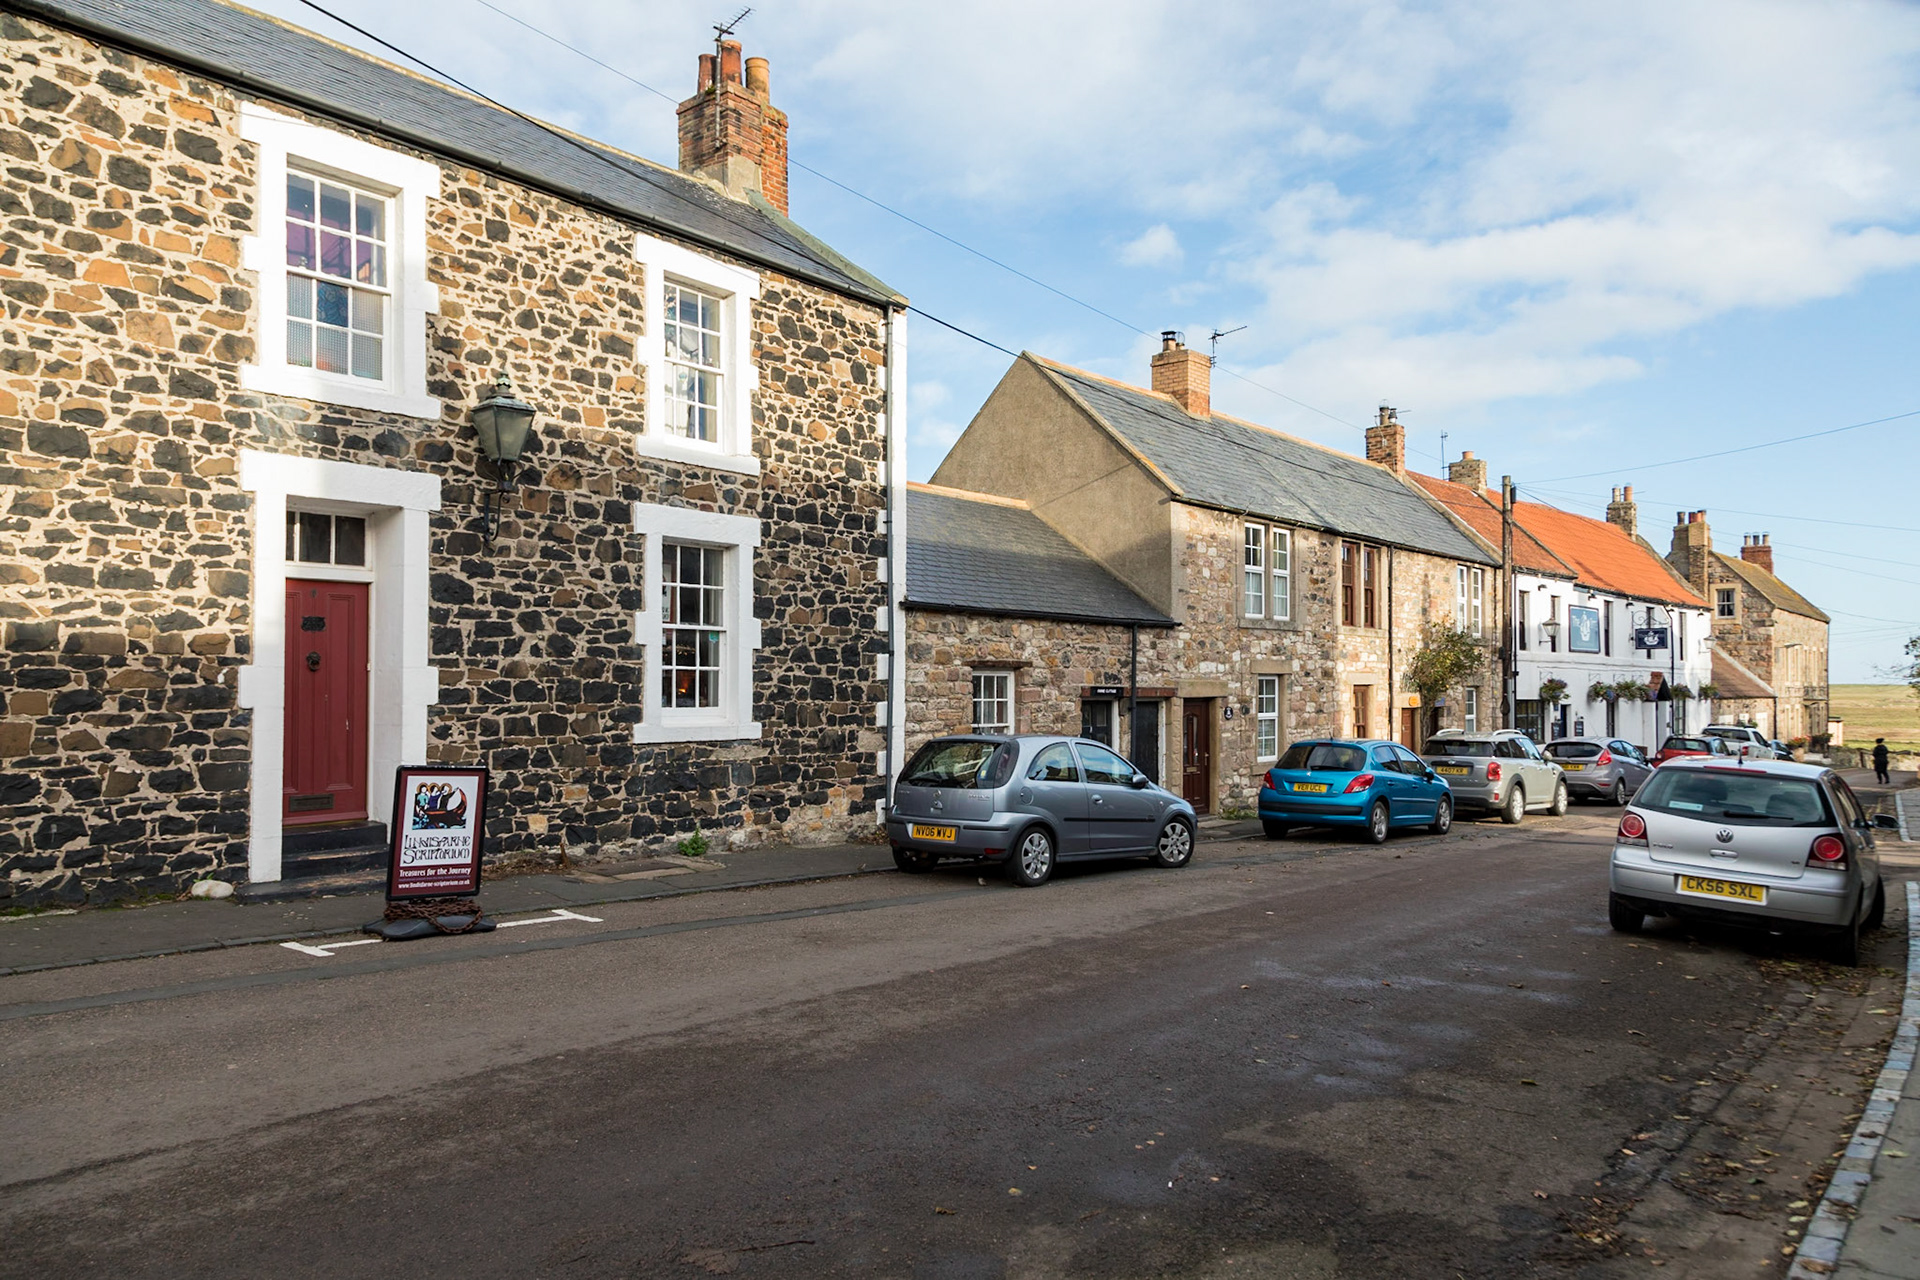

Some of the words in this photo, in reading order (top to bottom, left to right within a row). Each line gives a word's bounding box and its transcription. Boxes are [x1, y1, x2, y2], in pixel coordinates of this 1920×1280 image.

[916, 825, 935, 836] NV06
[403, 848, 470, 865] SCRIPTORIUM
[399, 869, 426, 877] Treasures
[427, 868, 436, 876] for
[448, 867, 472, 875] Journey
[1686, 877, 1725, 894] CK56
[1728, 884, 1757, 899] SXL
